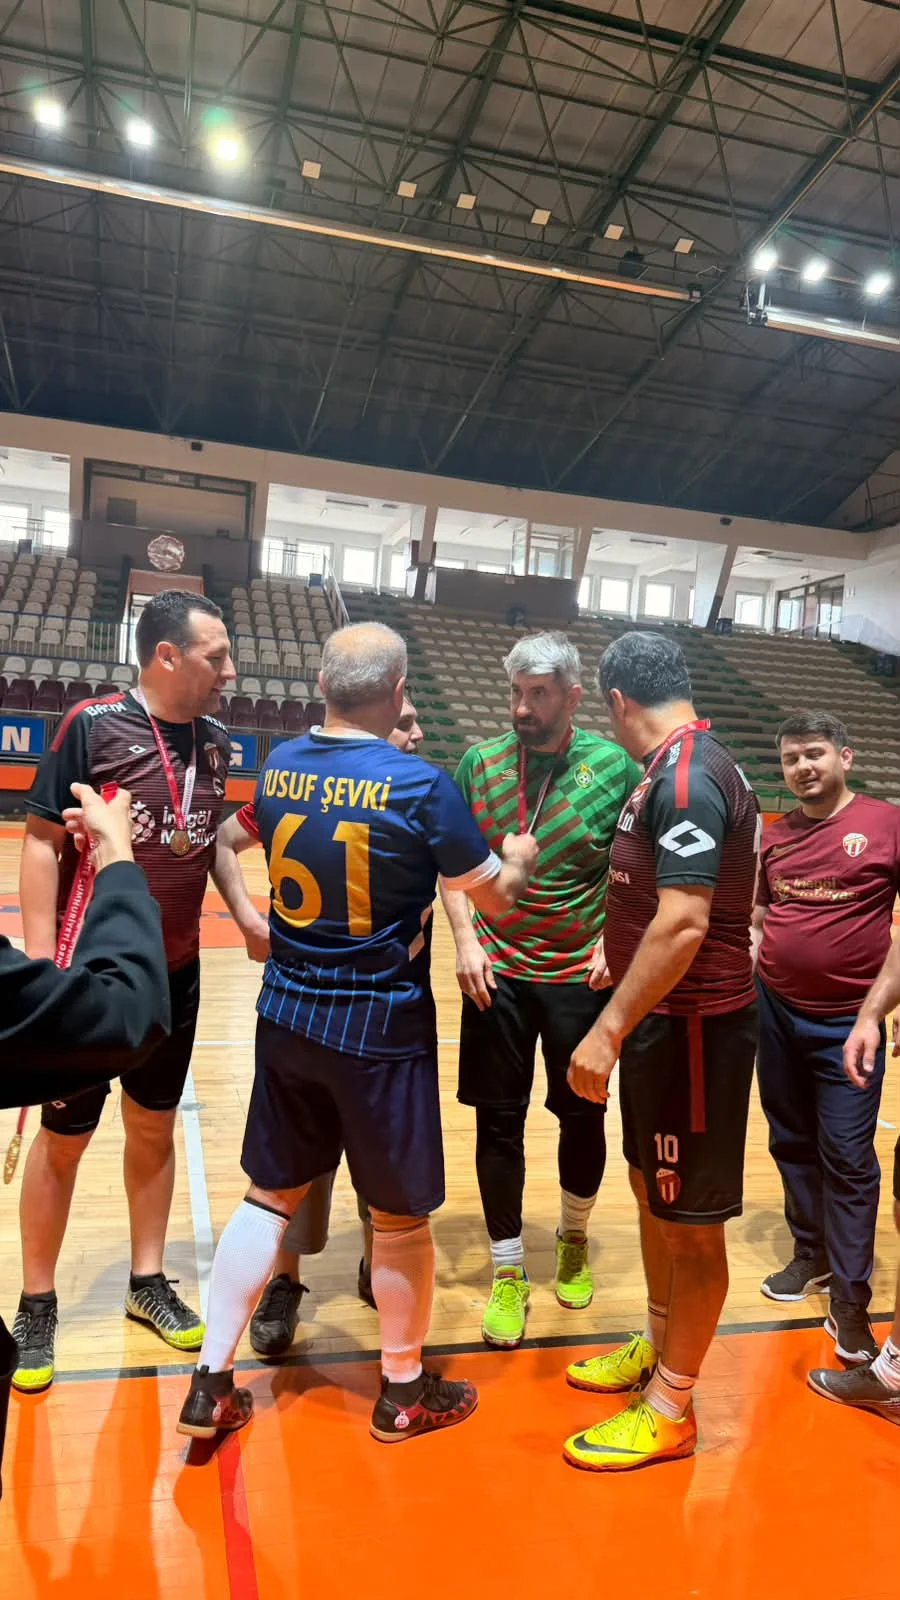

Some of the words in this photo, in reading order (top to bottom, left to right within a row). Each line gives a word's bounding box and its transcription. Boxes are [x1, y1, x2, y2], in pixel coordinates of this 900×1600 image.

[2, 726, 30, 752] N
[263, 769, 318, 802] YUSUF
[320, 776, 392, 813] ŞEVKİ
[162, 806, 212, 828] İngöl
[269, 812, 373, 937] 61
[654, 1133, 679, 1163] 10
